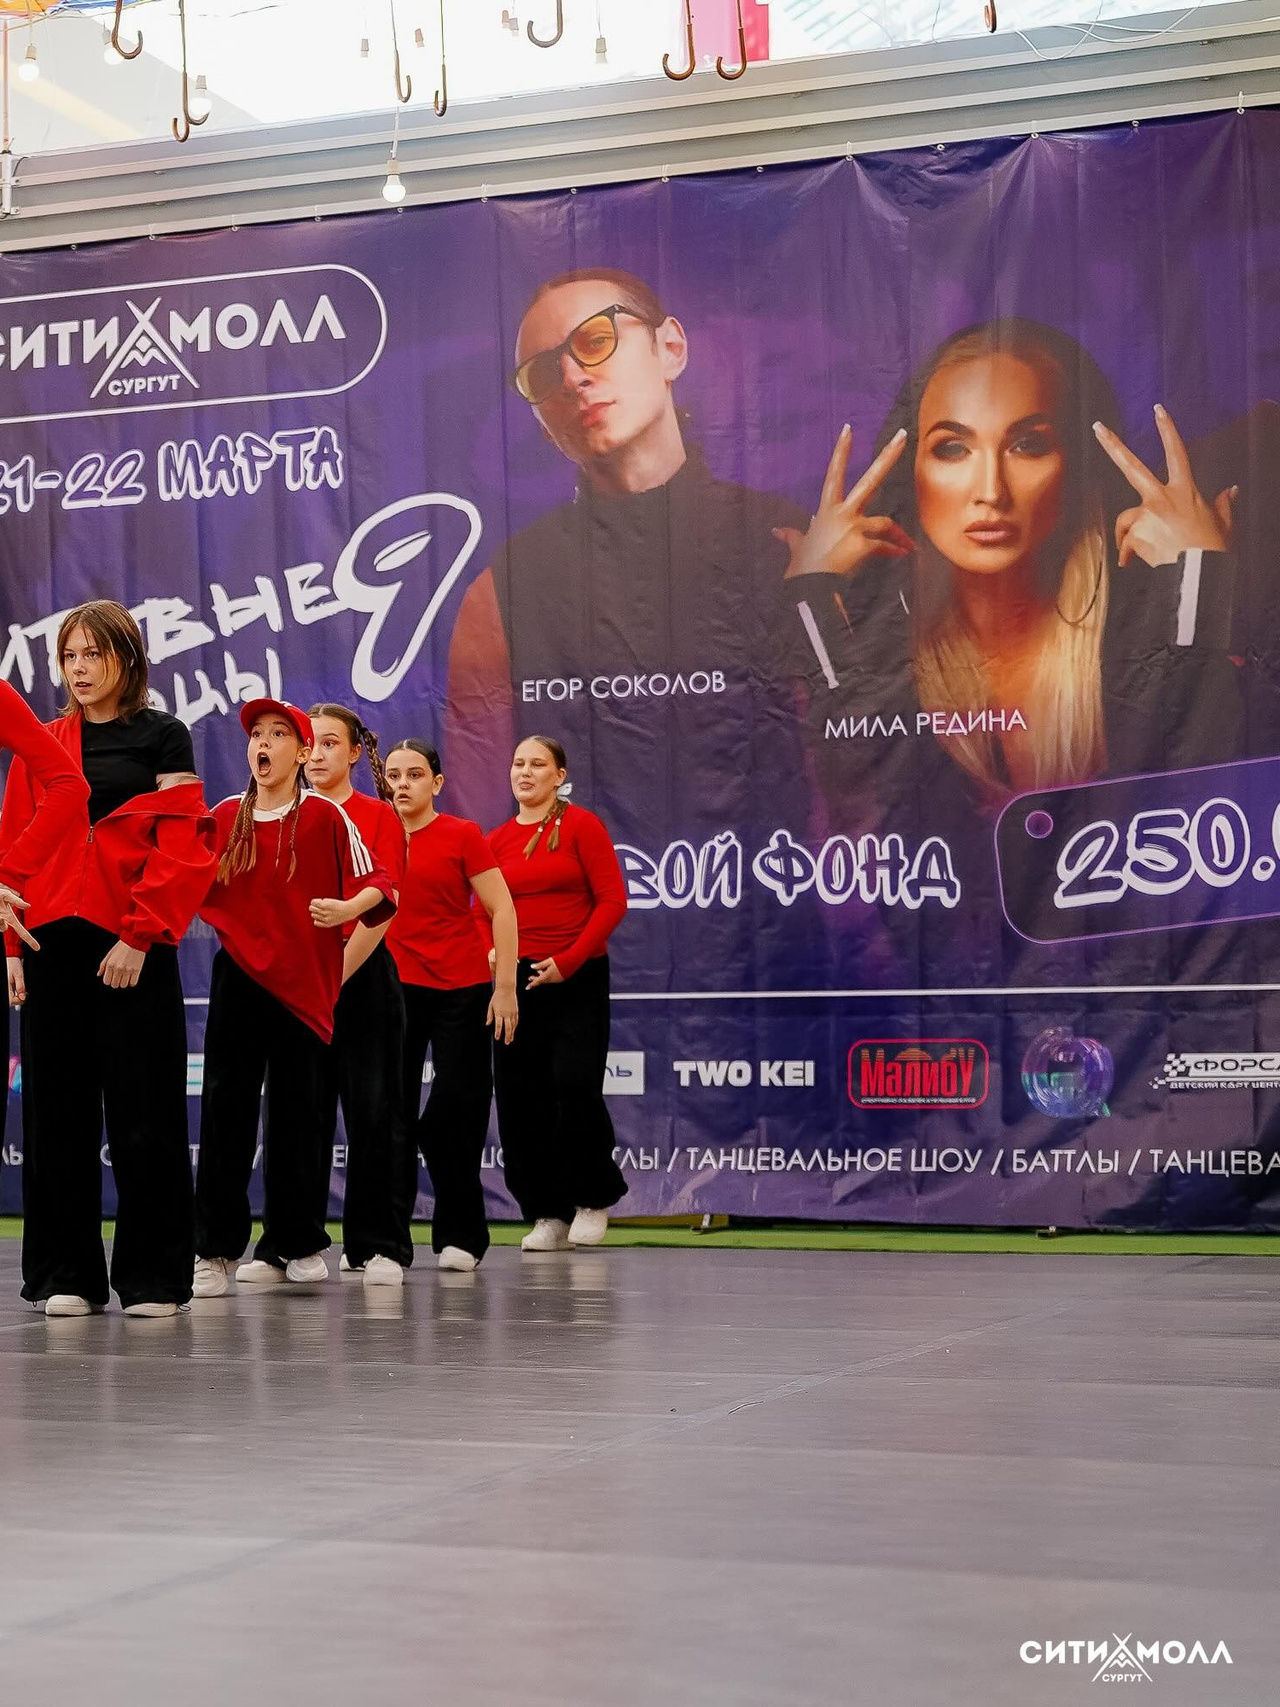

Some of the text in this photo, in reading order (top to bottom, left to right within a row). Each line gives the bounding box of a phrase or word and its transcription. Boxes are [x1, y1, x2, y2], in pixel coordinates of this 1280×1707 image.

[169, 295, 346, 353] МОЛЛ
[108, 374, 181, 396] СУРГУТ
[157, 426, 344, 501] МАРТА
[522, 670, 727, 702] ЕГОР СОКОЛОВ
[825, 708, 1028, 739] МИЛА РЕДИНА
[613, 828, 961, 910] ВОЙ ФОНД
[1053, 797, 1280, 909] 250.
[673, 1060, 815, 1087] TWO KEI
[686, 1147, 902, 1174] ТАНЦЕВАЛЬНОЕ
[910, 1147, 982, 1173] ШОУ
[1012, 1148, 1119, 1174] БАТТЛЫ
